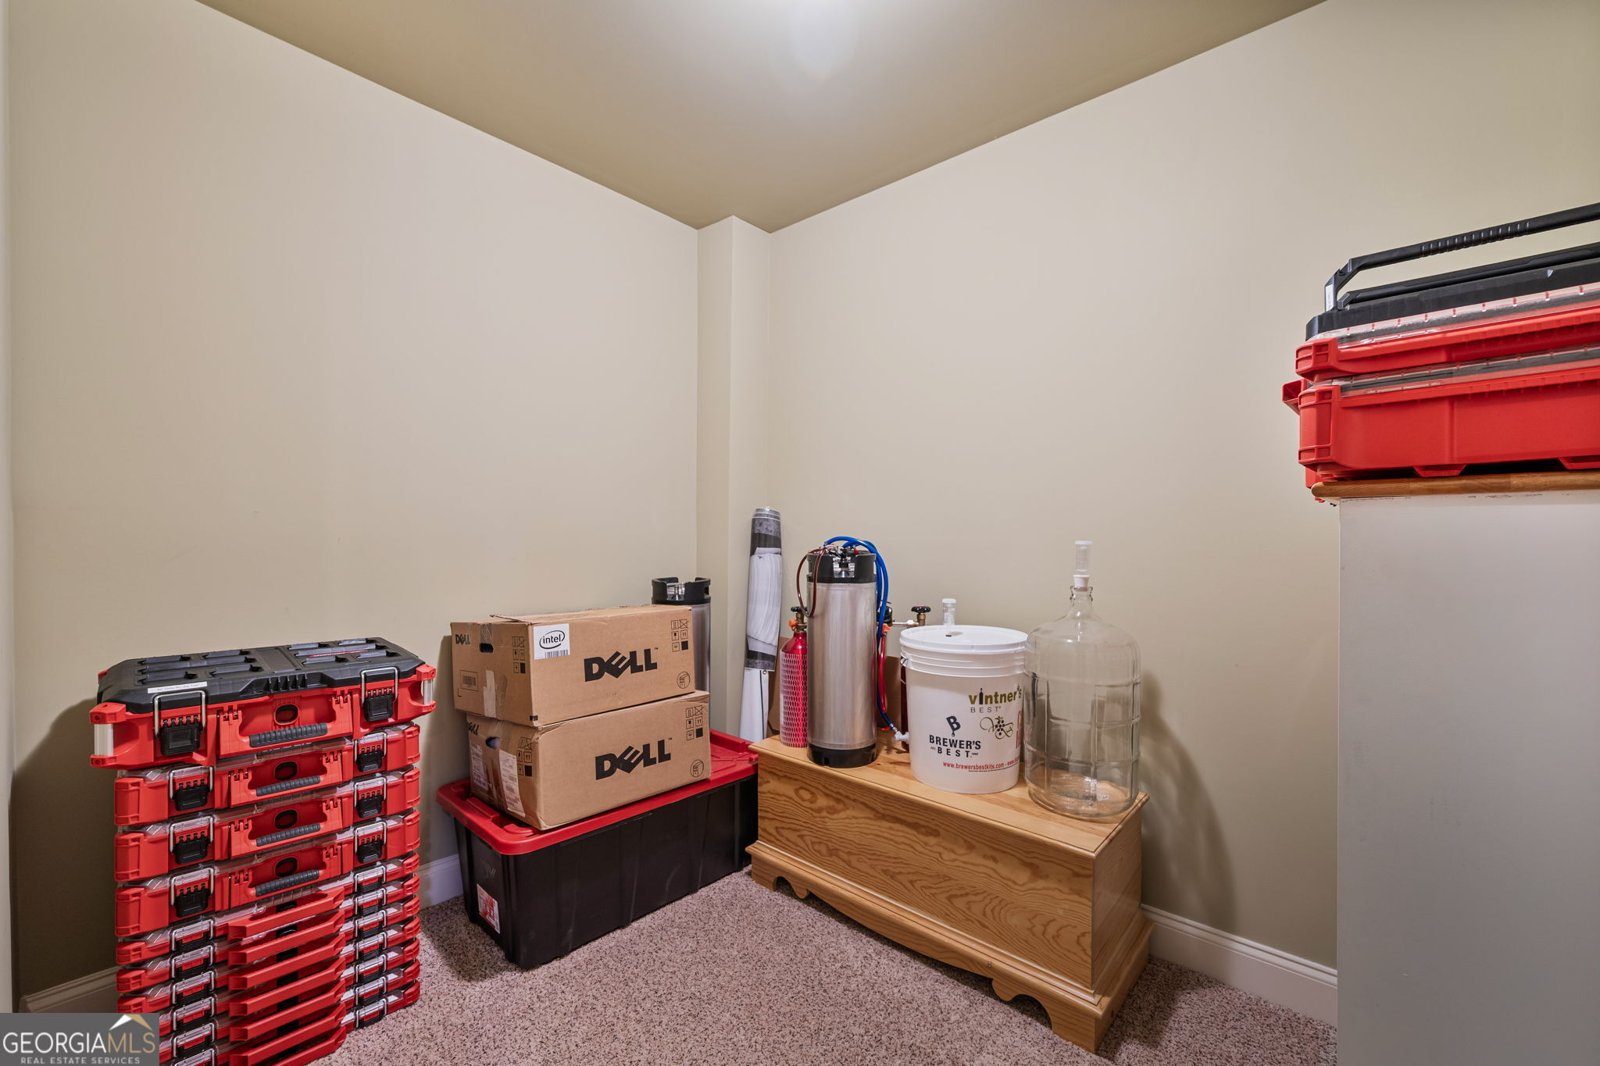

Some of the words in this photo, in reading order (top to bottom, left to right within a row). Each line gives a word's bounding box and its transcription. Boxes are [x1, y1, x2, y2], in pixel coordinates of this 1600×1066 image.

[455, 633, 471, 646] DELL
[542, 633, 562, 644] intel
[583, 647, 658, 682] DELL
[928, 734, 982, 750] BREWER'S
[937, 746, 971, 758] BEST
[595, 739, 672, 780] DELL
[943, 761, 1004, 770] www.brewersbestkits.com
